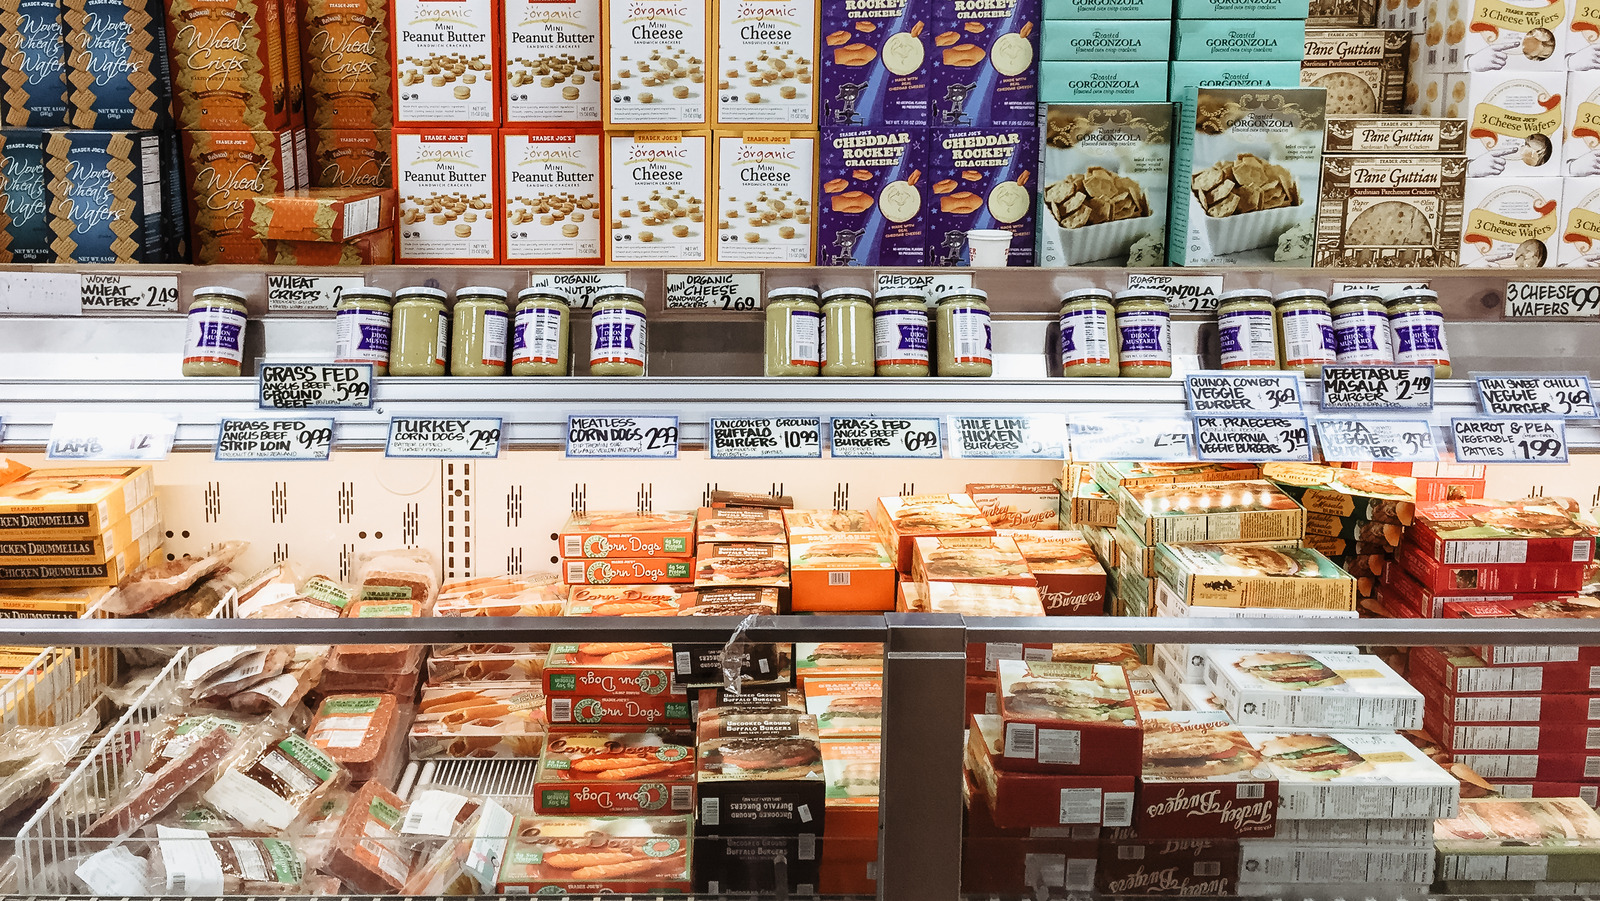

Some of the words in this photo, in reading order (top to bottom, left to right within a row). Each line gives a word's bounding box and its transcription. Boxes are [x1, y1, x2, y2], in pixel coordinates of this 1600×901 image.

[420, 6, 472, 21] organic
[633, 5, 688, 20] organic
[1480, 7, 1488, 17] 3
[1488, 10, 1524, 25] Cheese
[1525, 11, 1559, 28] Wafers
[78, 14, 135, 33] Woven
[435, 23, 454, 31] MINI
[178, 19, 252, 52] Wheat
[403, 31, 443, 42] Peanut
[449, 31, 485, 42] Butter
[632, 25, 684, 40] Cheese
[1071, 39, 1142, 47] GORGONZOLA
[1206, 39, 1278, 47] GORGONZOLA
[78, 51, 143, 86] Wafers
[187, 50, 249, 91] Crisps
[1227, 119, 1294, 128] GORGONZOLA
[833, 133, 911, 149] CHEDDAR
[530, 147, 581, 162] organic
[843, 146, 904, 159] ROCKET
[845, 159, 899, 167] CRACKERS
[512, 171, 554, 183] Peanut
[557, 171, 594, 183] Butter
[1354, 167, 1386, 183] Pane
[1390, 169, 1438, 187] Guttiau
[86, 275, 120, 284] WOVEN
[269, 276, 320, 289] WHEAT
[554, 275, 601, 284] ORGANIC
[686, 275, 733, 285] ORGANIC
[879, 275, 935, 285] CHEDDAR
[1130, 276, 1172, 284] ROASTED
[81, 285, 131, 296] WHEAT
[667, 281, 685, 294] MINI
[684, 284, 739, 296] CHEESE
[1507, 284, 1518, 302] 3
[1521, 284, 1576, 300] CHEESE
[269, 290, 321, 300] CRISPS
[82, 296, 140, 306] WAFERS
[1512, 302, 1569, 317] WAFERS
[263, 367, 316, 382] GRASS
[323, 368, 358, 381] FED
[1325, 369, 1410, 380] VEGETABLE
[263, 382, 299, 391] ANGUS
[302, 382, 331, 390] BEEF
[1190, 378, 1231, 387] QUINOA
[1234, 378, 1280, 387] COWBOY
[1325, 380, 1389, 393] MASALA
[1480, 379, 1505, 389] THAI
[1507, 379, 1539, 388] SWEET
[1543, 379, 1580, 388] CHILLI
[263, 390, 322, 401] GROUND
[1192, 388, 1245, 399] VEGGIE
[1328, 393, 1390, 404] BURGER
[1483, 390, 1537, 403] VEGGIE
[274, 400, 313, 408] BEEF
[1195, 400, 1255, 410] BURGER
[1492, 403, 1555, 414] BURGER
[224, 421, 269, 431] GRASS
[273, 422, 305, 431] FED
[393, 420, 470, 433] TURKEY
[572, 418, 636, 429] MEATLESS
[715, 420, 771, 428] UNCOOKED
[776, 419, 819, 427] GROUND
[833, 419, 878, 429] GRASS
[882, 421, 911, 429] FED
[1223, 418, 1292, 428] PRAEGERS
[1455, 423, 1504, 434] CARROT
[1511, 422, 1523, 434] &
[1525, 423, 1554, 433] PEA
[222, 431, 259, 441] ANGUS
[260, 432, 288, 440] BEEF
[395, 433, 428, 441] CORN
[432, 432, 464, 441] DOGS
[570, 429, 608, 442] CORN
[611, 428, 643, 441] DOGS
[714, 429, 772, 438] BUFFALO
[1200, 431, 1269, 444] CALIFORNIA
[1458, 435, 1515, 443] VEGETABLE
[220, 441, 257, 451] STRIP
[260, 441, 291, 451] LOIN
[715, 438, 777, 447] BURGERS
[834, 438, 890, 446] BURGERS
[964, 442, 1019, 450] BURGERS
[1200, 444, 1235, 454] VEGGIE
[1236, 444, 1281, 454] BURGERS
[1462, 446, 1504, 456] PATTIES
[22, 514, 84, 527] DRUMMELLAS
[1008, 509, 1056, 528] Burgers
[599, 537, 627, 554] Corn
[629, 537, 661, 555] Dogs
[41, 565, 103, 578] DRUMMELLAS
[1047, 591, 1102, 612] Burgers
[590, 700, 623, 717] Corn
[628, 701, 662, 721] Dogs
[550, 740, 600, 754] Corn
[604, 740, 656, 758] Dogs
[574, 786, 613, 807] Dogs
[615, 791, 651, 807] Corn
[1146, 788, 1221, 817] Burgers
[1220, 800, 1273, 829] Turkey
